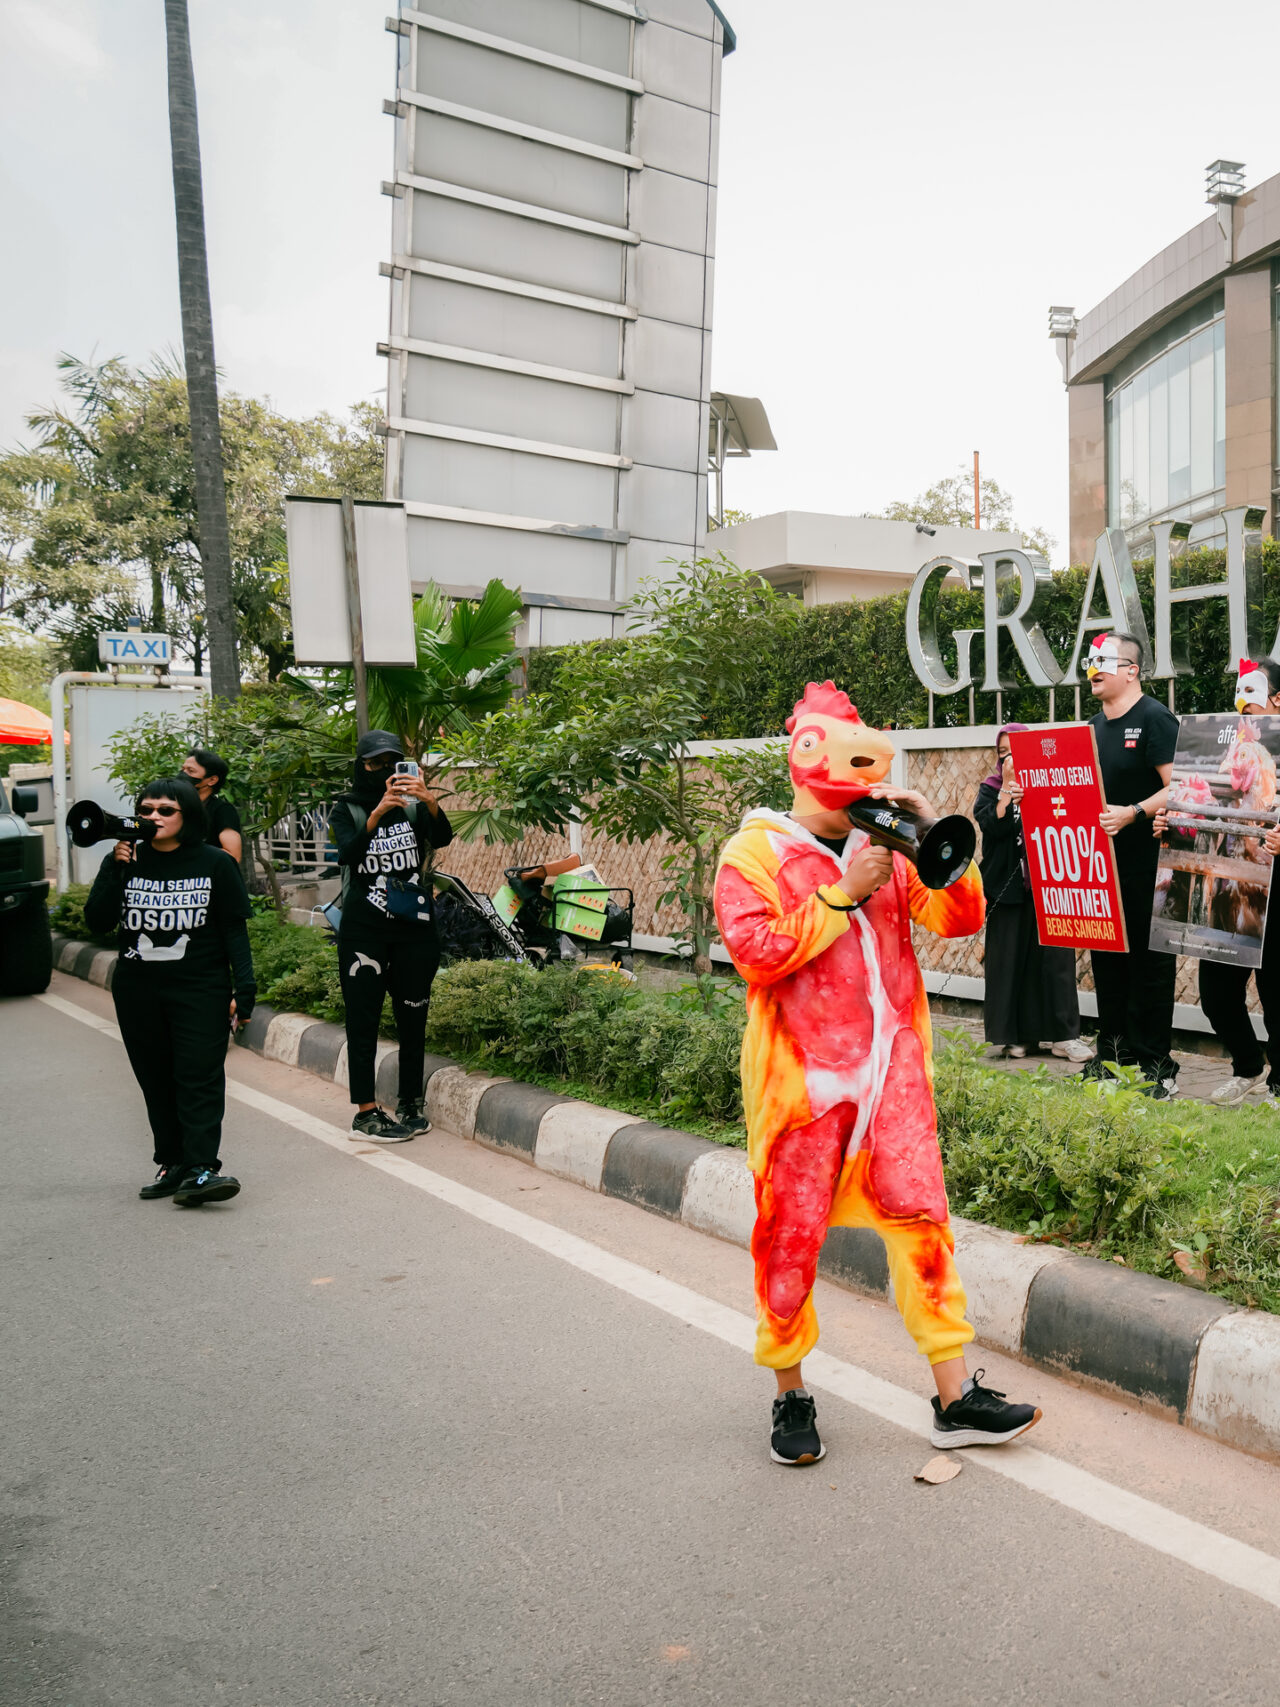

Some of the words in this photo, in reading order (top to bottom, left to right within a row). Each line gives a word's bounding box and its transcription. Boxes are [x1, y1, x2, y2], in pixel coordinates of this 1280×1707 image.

[106, 639, 167, 658] TAXI
[1217, 725, 1237, 744] affa
[1018, 769, 1030, 789] 17
[1030, 768, 1050, 788] DARI
[1049, 768, 1067, 787] 300
[1067, 766, 1094, 786] GERAI
[875, 811, 893, 828] affa
[358, 848, 420, 874] OSON
[1031, 825, 1108, 884] 100%
[167, 877, 212, 891] SEMUA
[127, 892, 208, 906] ERANGKENG
[1041, 886, 1112, 918] KOMITMEN
[122, 908, 207, 931] OSONG
[1045, 917, 1074, 938] BEBAS
[1075, 919, 1116, 941] SANGKAR
